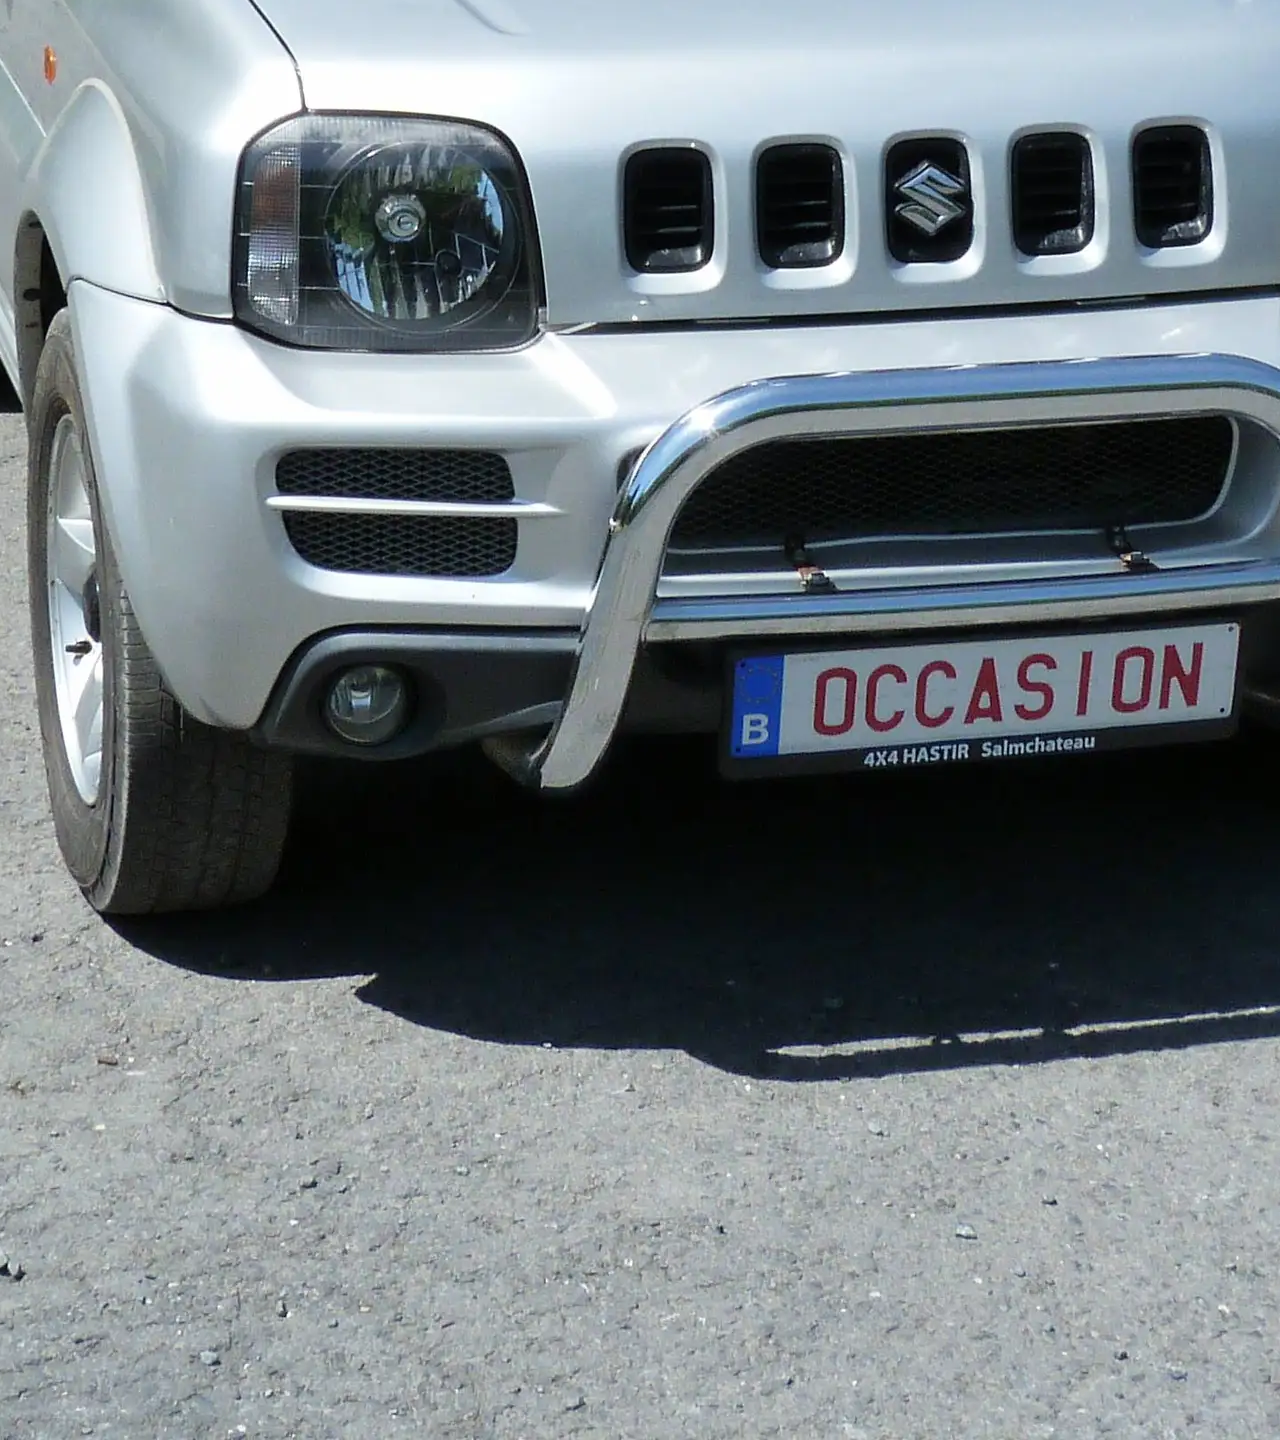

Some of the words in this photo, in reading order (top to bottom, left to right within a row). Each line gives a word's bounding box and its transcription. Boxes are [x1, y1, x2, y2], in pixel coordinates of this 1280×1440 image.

[812, 642, 1205, 736] OCCASION
[741, 712, 770, 746] B
[863, 750, 900, 767] 4X4
[902, 743, 970, 765] HASTIR
[980, 734, 1096, 758] Salmchateau
